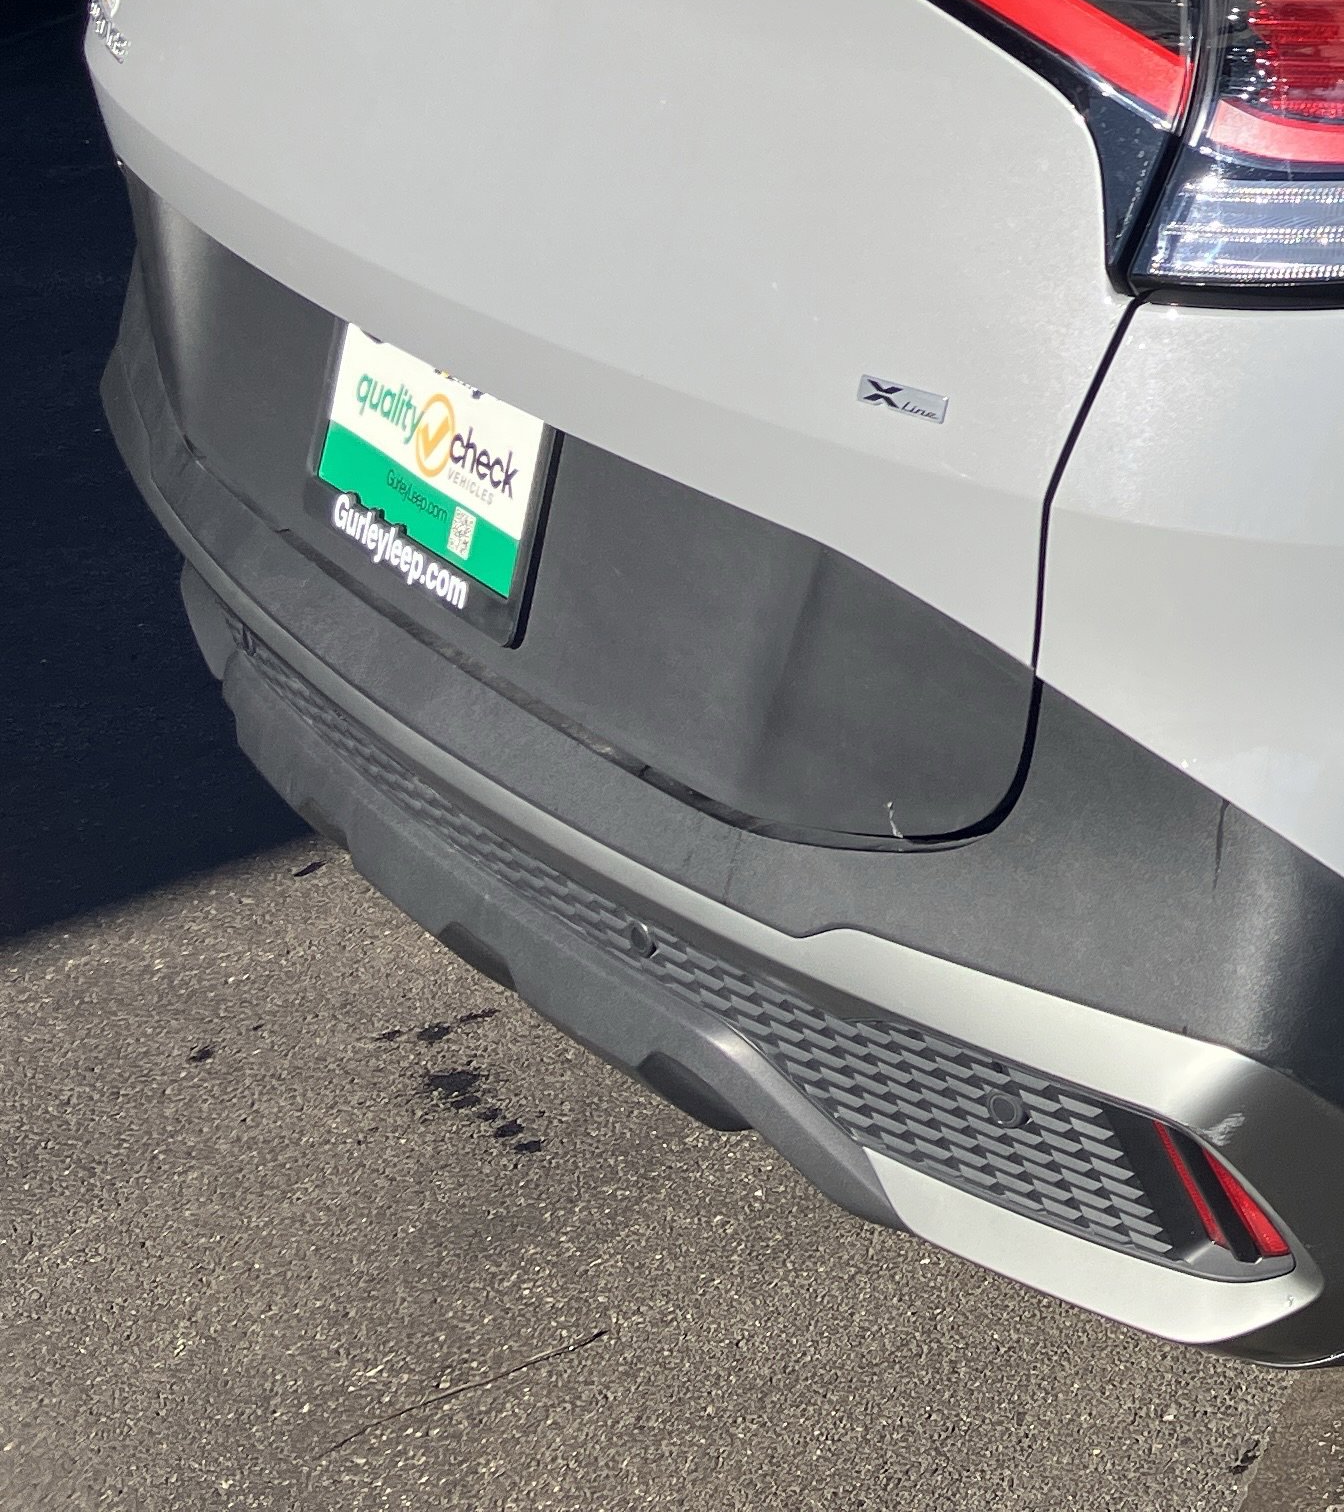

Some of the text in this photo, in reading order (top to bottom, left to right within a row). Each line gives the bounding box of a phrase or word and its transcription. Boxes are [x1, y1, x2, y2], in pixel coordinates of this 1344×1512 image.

[355, 372, 519, 500] quality check
[446, 467, 496, 507] VEHICLES
